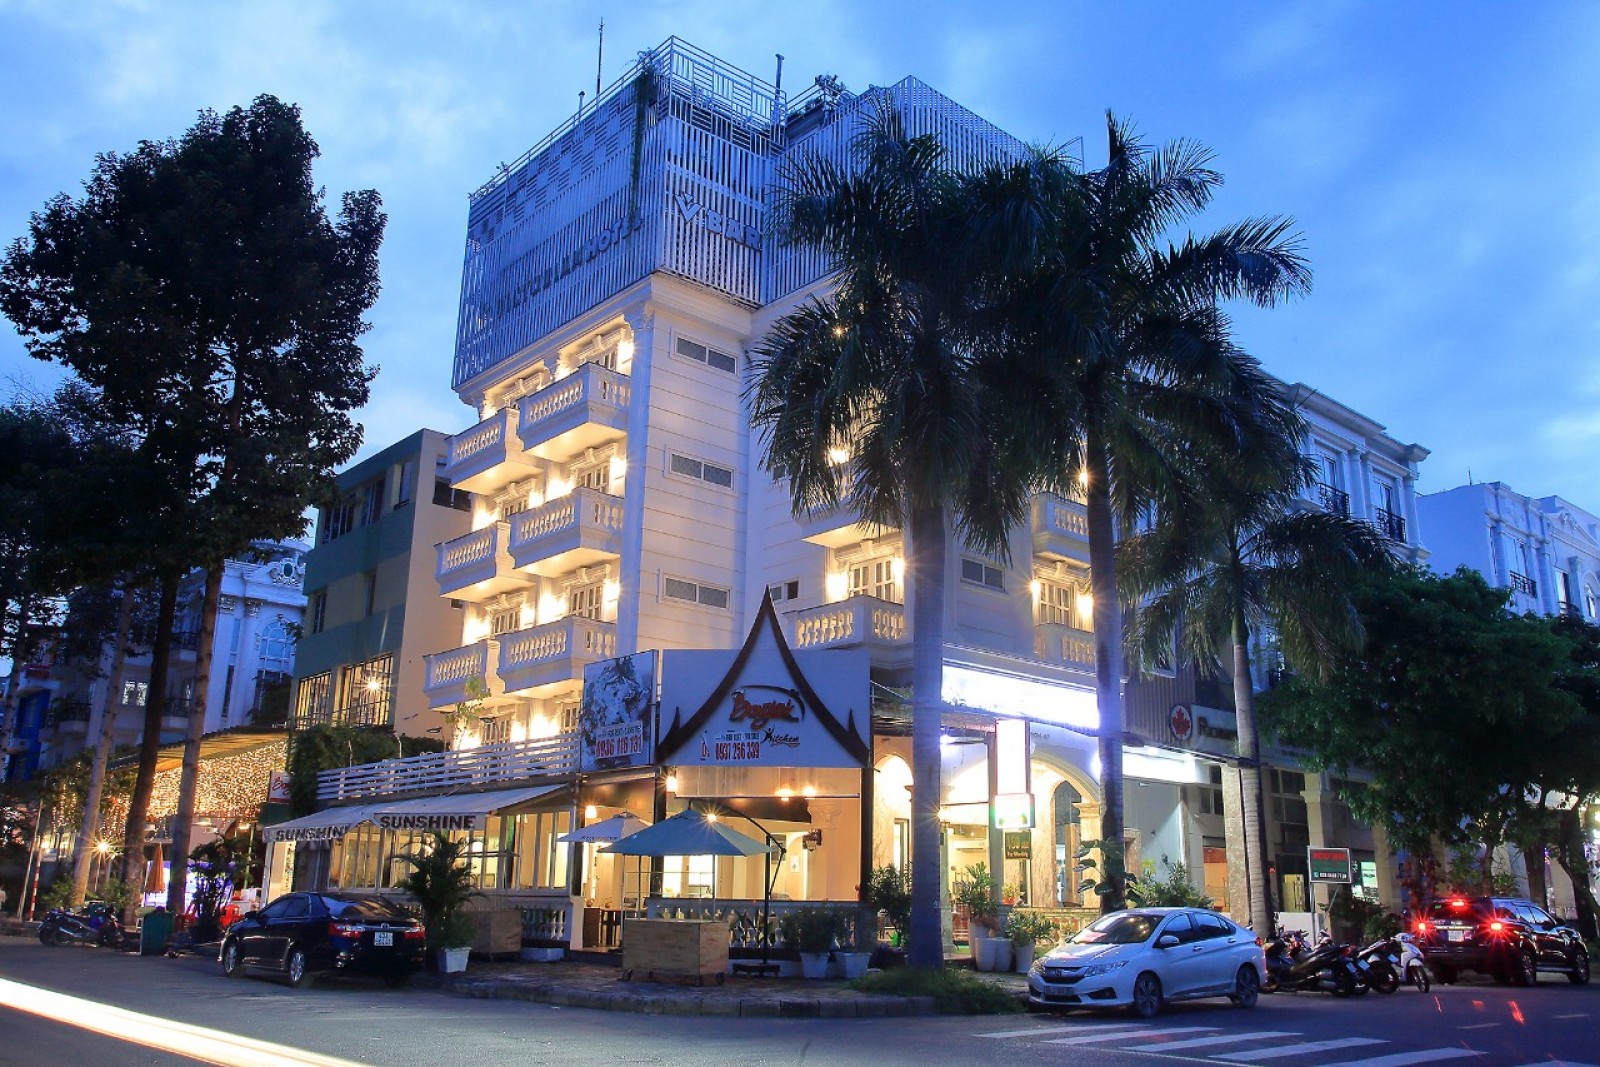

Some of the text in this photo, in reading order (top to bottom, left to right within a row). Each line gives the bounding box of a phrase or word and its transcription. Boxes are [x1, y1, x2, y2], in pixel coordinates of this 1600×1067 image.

[585, 211, 644, 260] HOTEL
[706, 210, 762, 251] BAR
[760, 725, 800, 746] Kitchen
[380, 815, 477, 830] SUNSHINE
